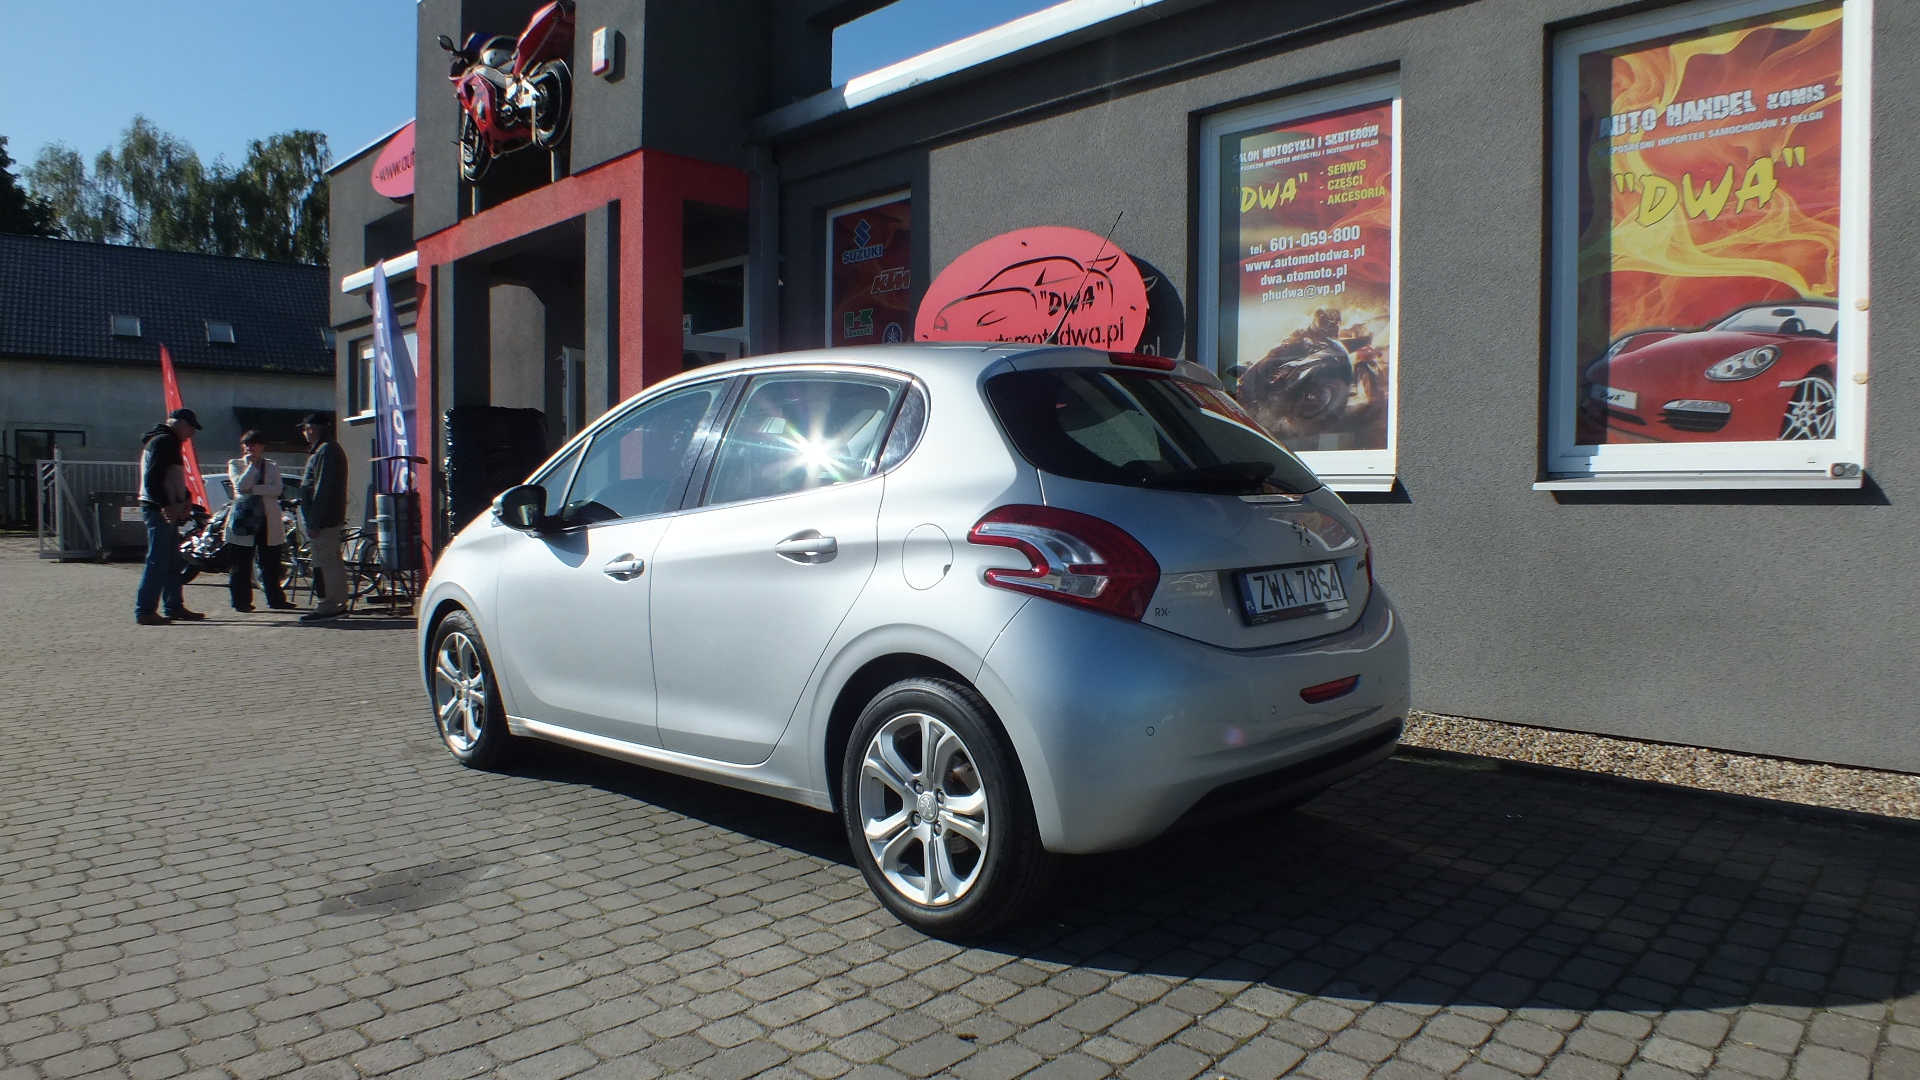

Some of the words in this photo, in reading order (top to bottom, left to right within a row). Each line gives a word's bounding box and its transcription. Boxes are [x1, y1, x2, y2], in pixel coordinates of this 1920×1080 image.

[1598, 108, 1657, 140] AUTO
[1666, 90, 1757, 126] HANDEL
[1766, 84, 1825, 110] KOMIS
[1262, 138, 1315, 159] MOTOCYKLI
[1317, 136, 1322, 148] I
[1325, 122, 1379, 145] SKUTERÓW
[1658, 131, 1706, 147] IMPORTER
[1708, 118, 1778, 138] SAMOCHODÓW
[1327, 159, 1367, 177] SERWIS
[1327, 174, 1363, 190] CZĘŚCI
[1327, 186, 1387, 206] AKCESORIA
[1614, 145, 1806, 229] "DWA"
[842, 244, 883, 264] SUZUKI
[1249, 244, 1266, 256] tel.
[1269, 225, 1360, 252] 601-059-800
[1245, 244, 1366, 272] www.automotodwa.pl
[1260, 263, 1349, 286] dwa.otomoto.pl
[1039, 281, 1104, 316] "DWA"
[1262, 280, 1346, 304] phudwa@vp.pl
[1253, 572, 1298, 610] ZWA
[1295, 565, 1341, 602] 78S4
